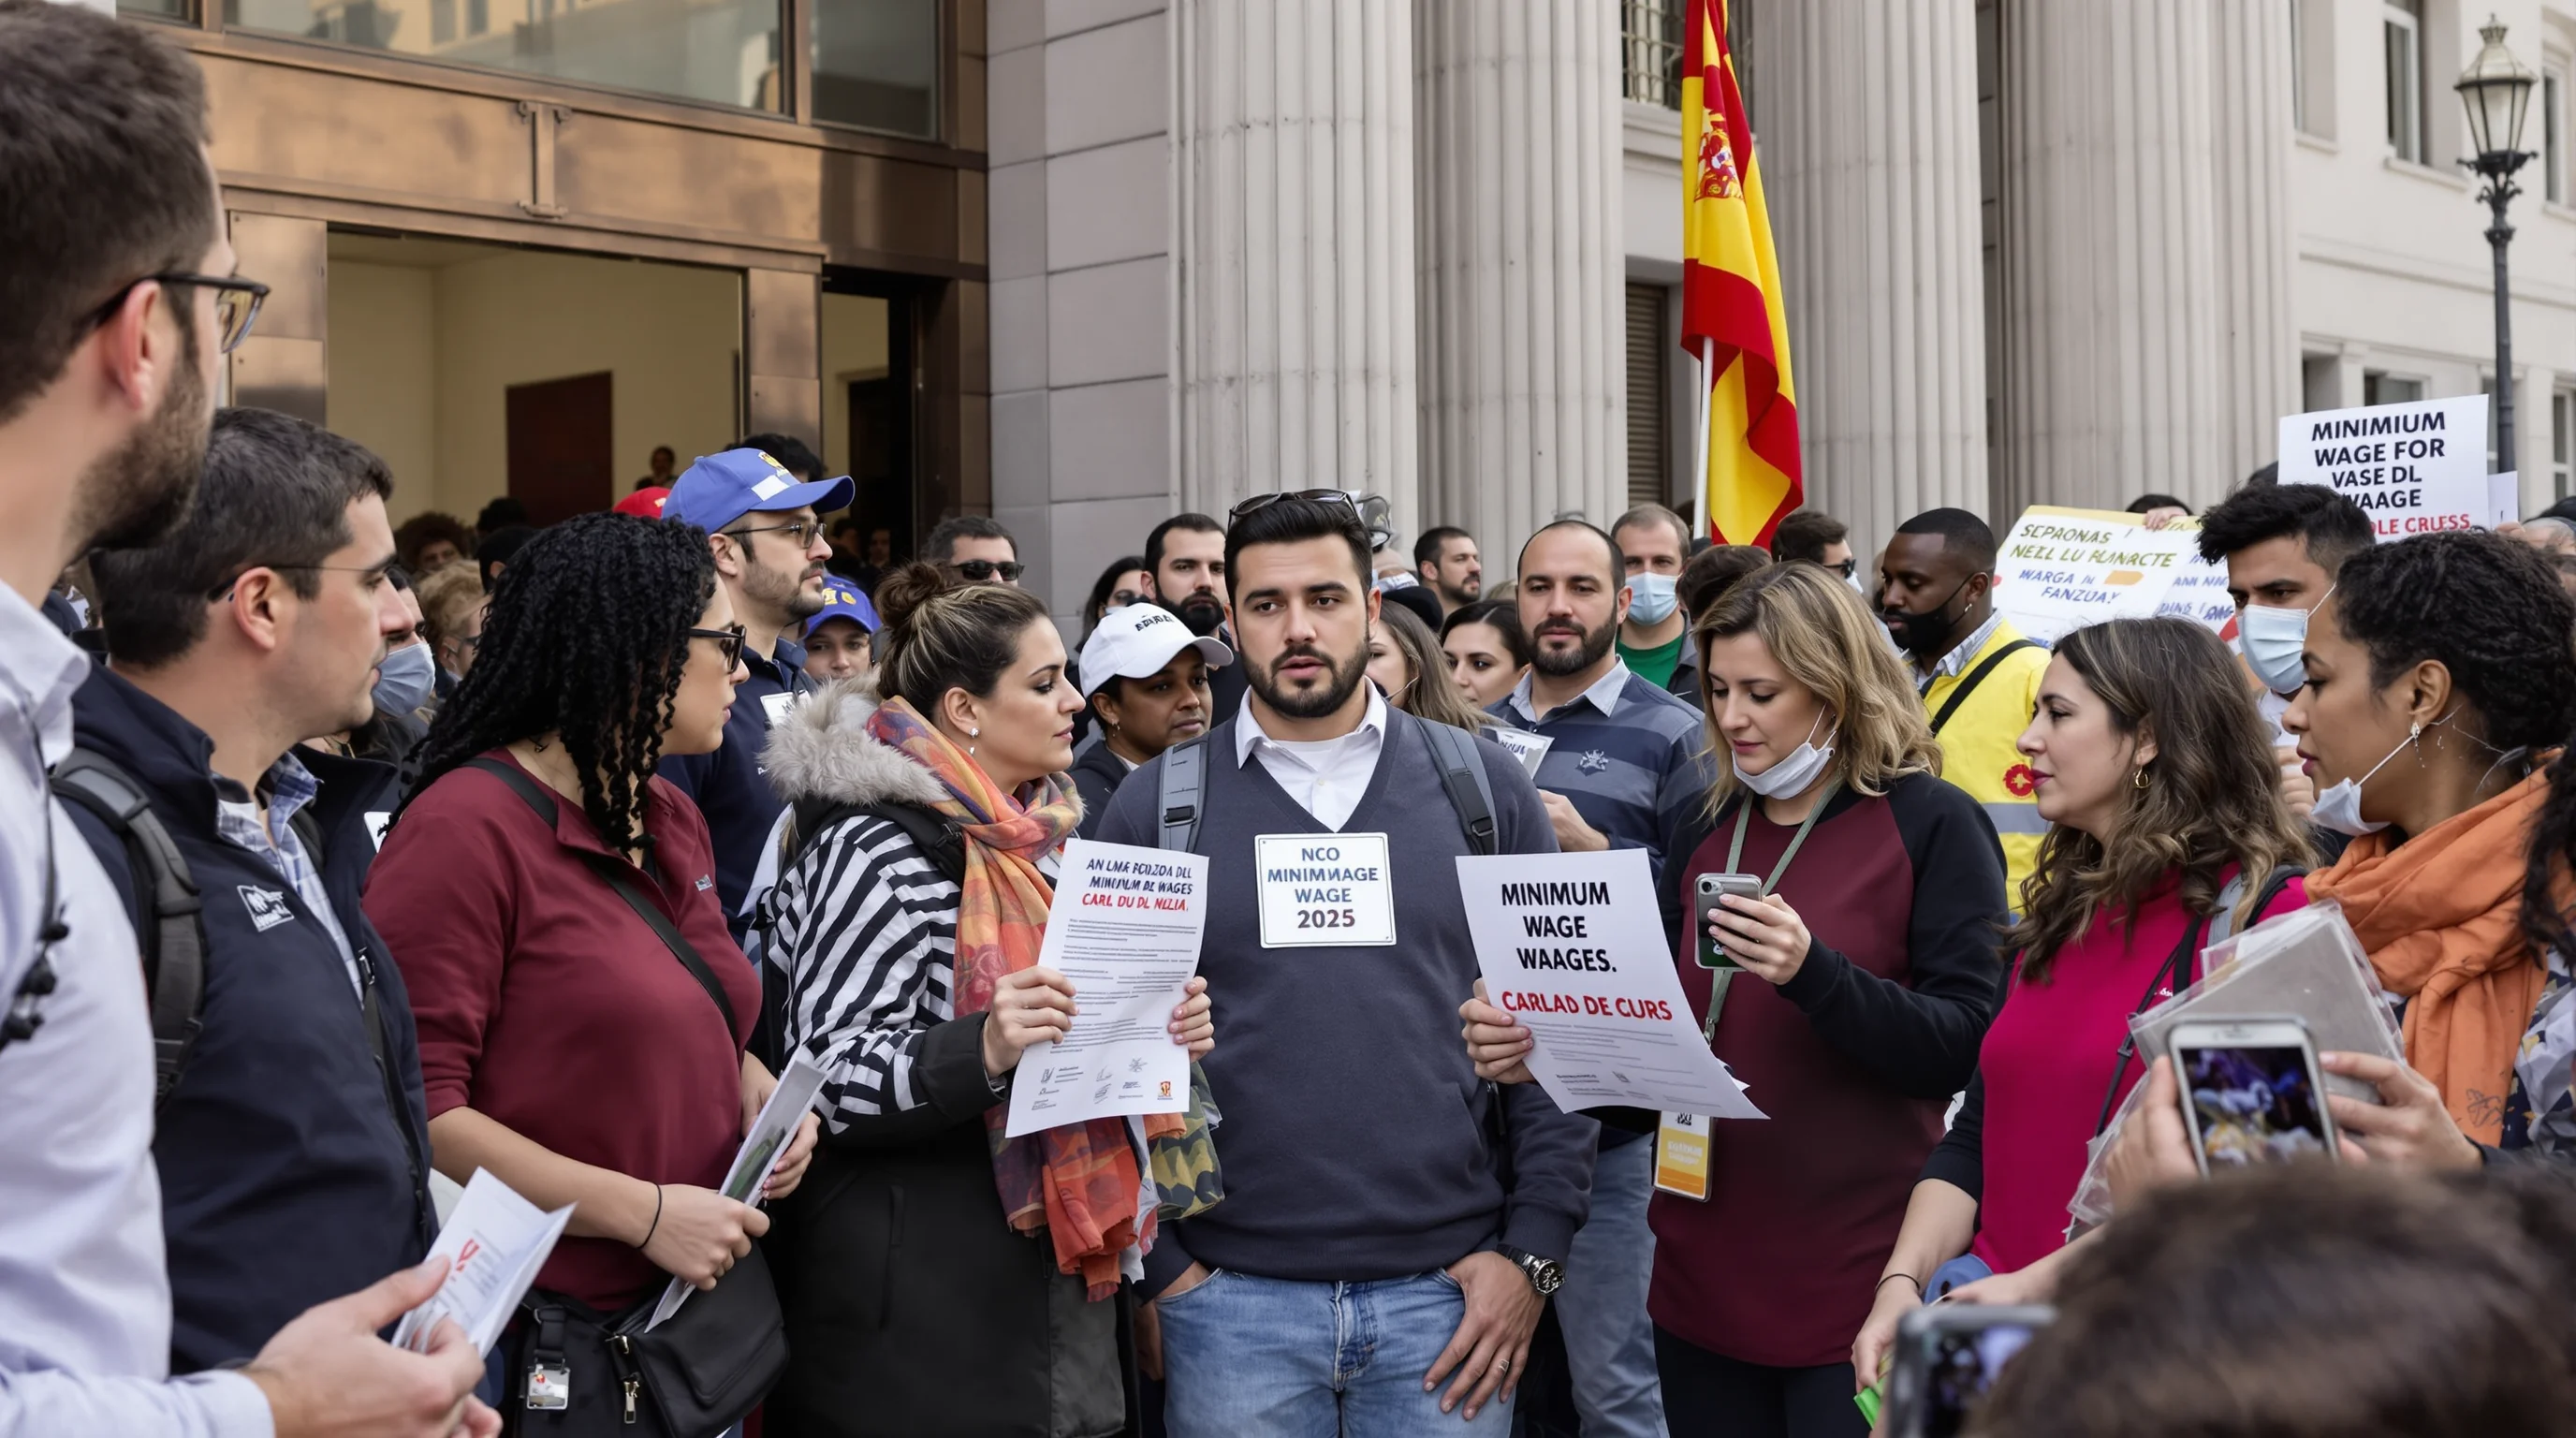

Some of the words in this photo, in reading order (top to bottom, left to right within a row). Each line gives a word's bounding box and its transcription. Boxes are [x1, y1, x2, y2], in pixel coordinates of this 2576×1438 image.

[2311, 411, 2446, 442] MINIMIUM
[2314, 443, 2387, 467] WAGE
[2393, 438, 2446, 461] FOR
[2332, 467, 2386, 489] VASE
[2392, 465, 2422, 483] DL
[1301, 847, 1340, 861] NCO
[1295, 888, 1353, 903] WAGE
[1501, 881, 1611, 906] MINIMUM
[1297, 909, 1355, 929] 2025
[1522, 916, 1588, 938] WAGE
[1516, 947, 1617, 973] WAAGES.
[1501, 990, 1580, 1014] CARLAD
[1583, 995, 1613, 1016] DE
[1615, 997, 1673, 1020] CURS
